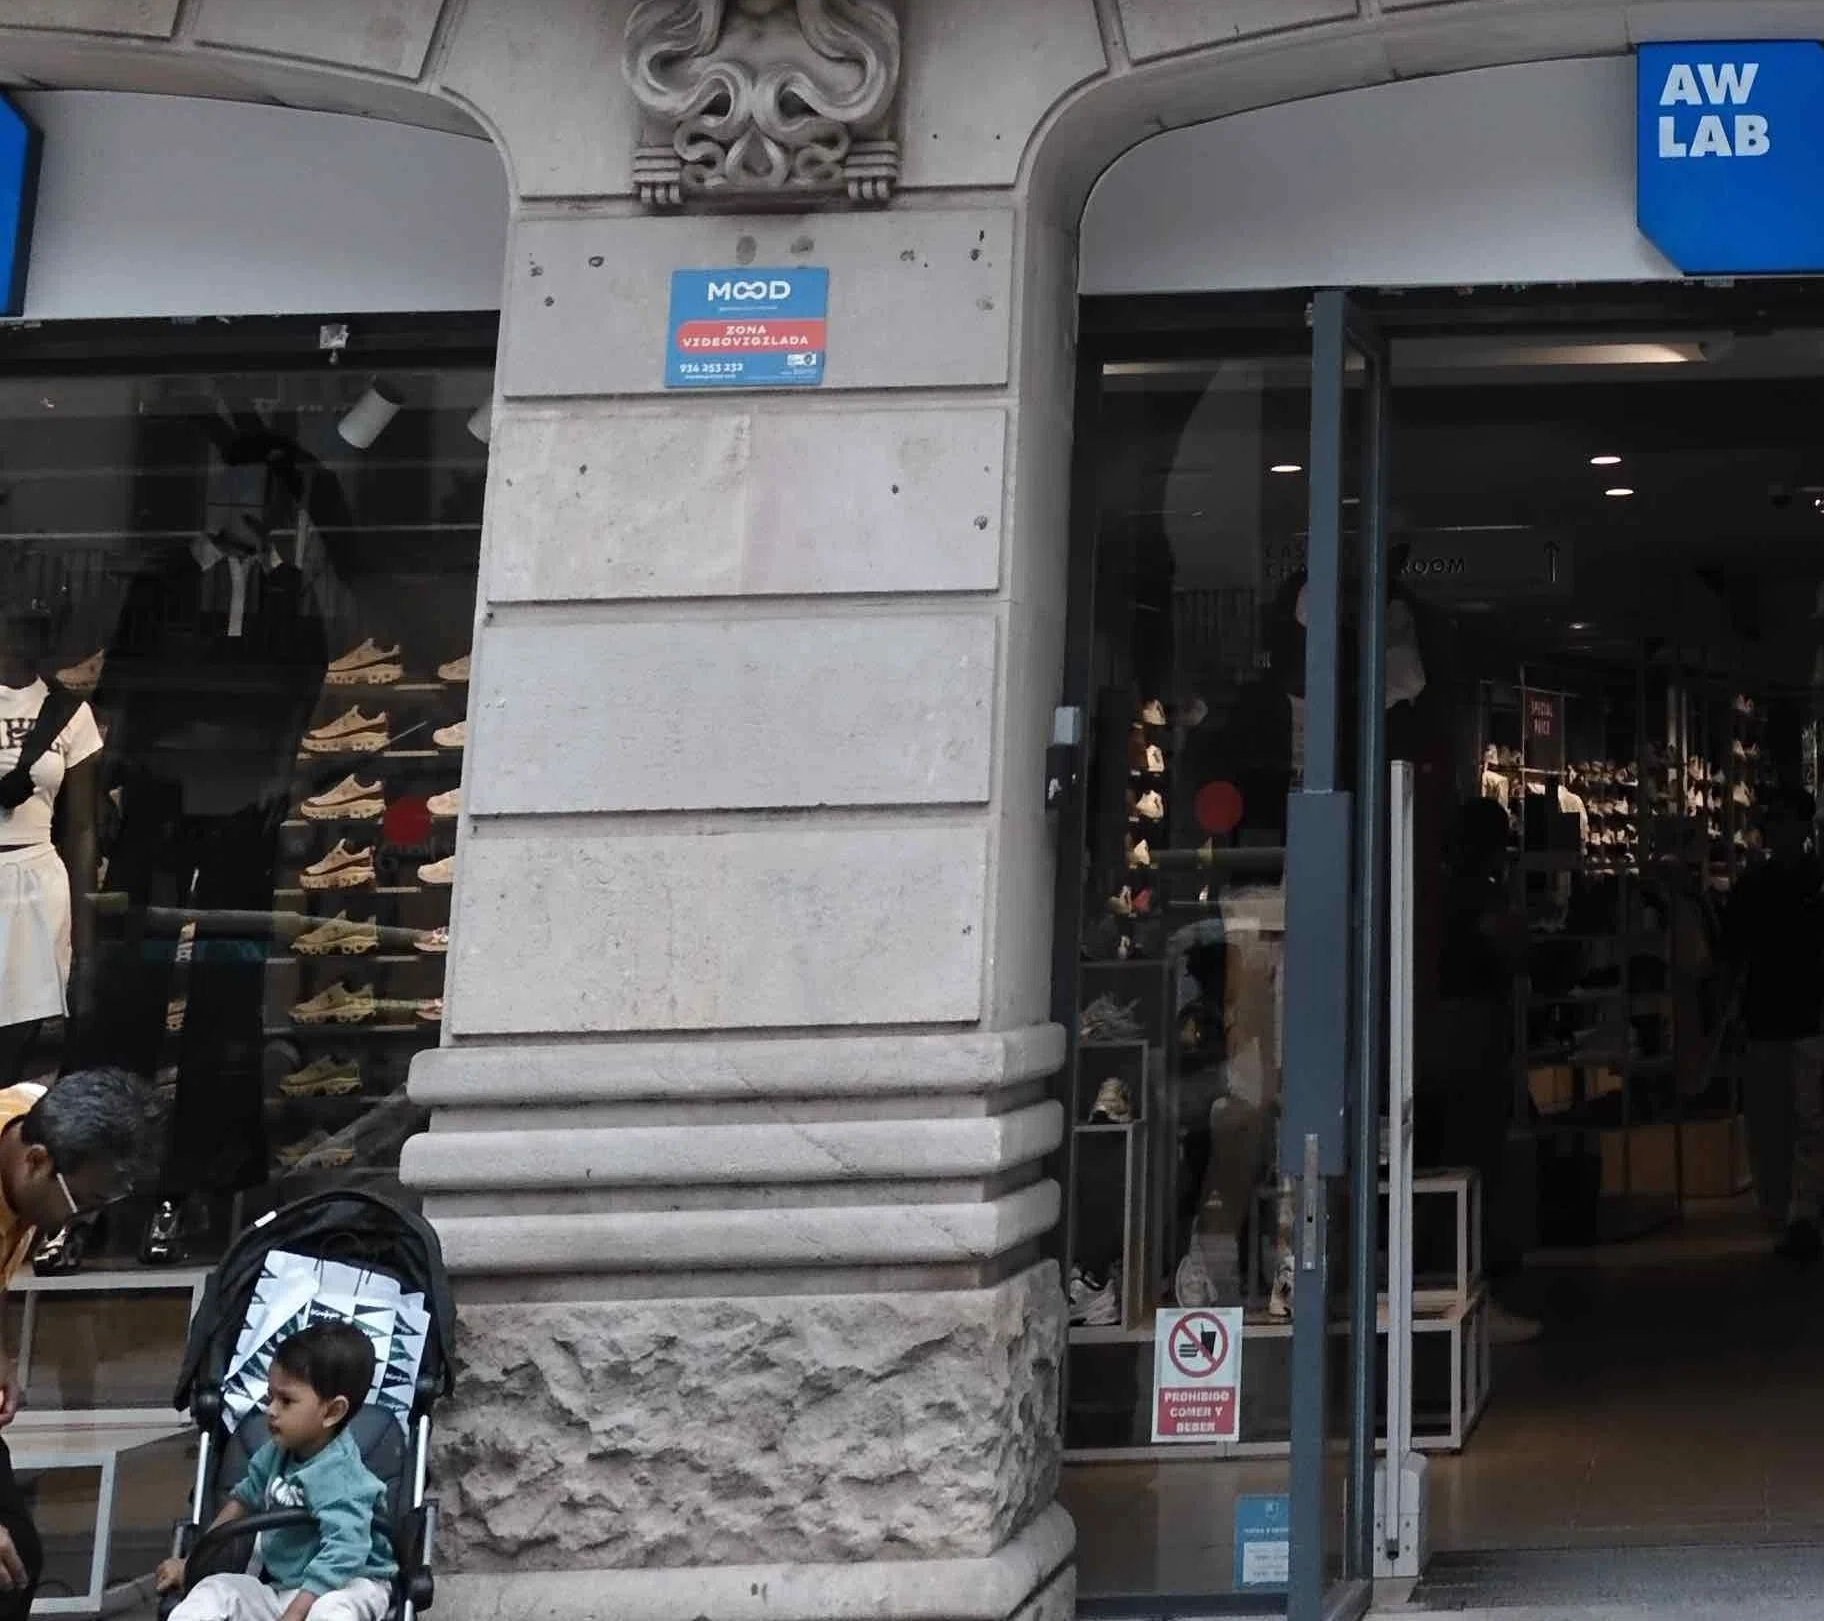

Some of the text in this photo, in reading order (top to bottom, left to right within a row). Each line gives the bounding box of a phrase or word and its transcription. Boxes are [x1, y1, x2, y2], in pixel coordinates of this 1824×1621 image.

[1659, 63, 1760, 106] AW
[1659, 114, 1770, 158] LAB
[708, 280, 792, 302] MOOD
[726, 324, 767, 335] ZONA
[682, 335, 809, 348] VIDEOVIGILADA
[1164, 1389, 1230, 1403] PROHIBIDO
[1169, 1405, 1224, 1418] COMER Y
